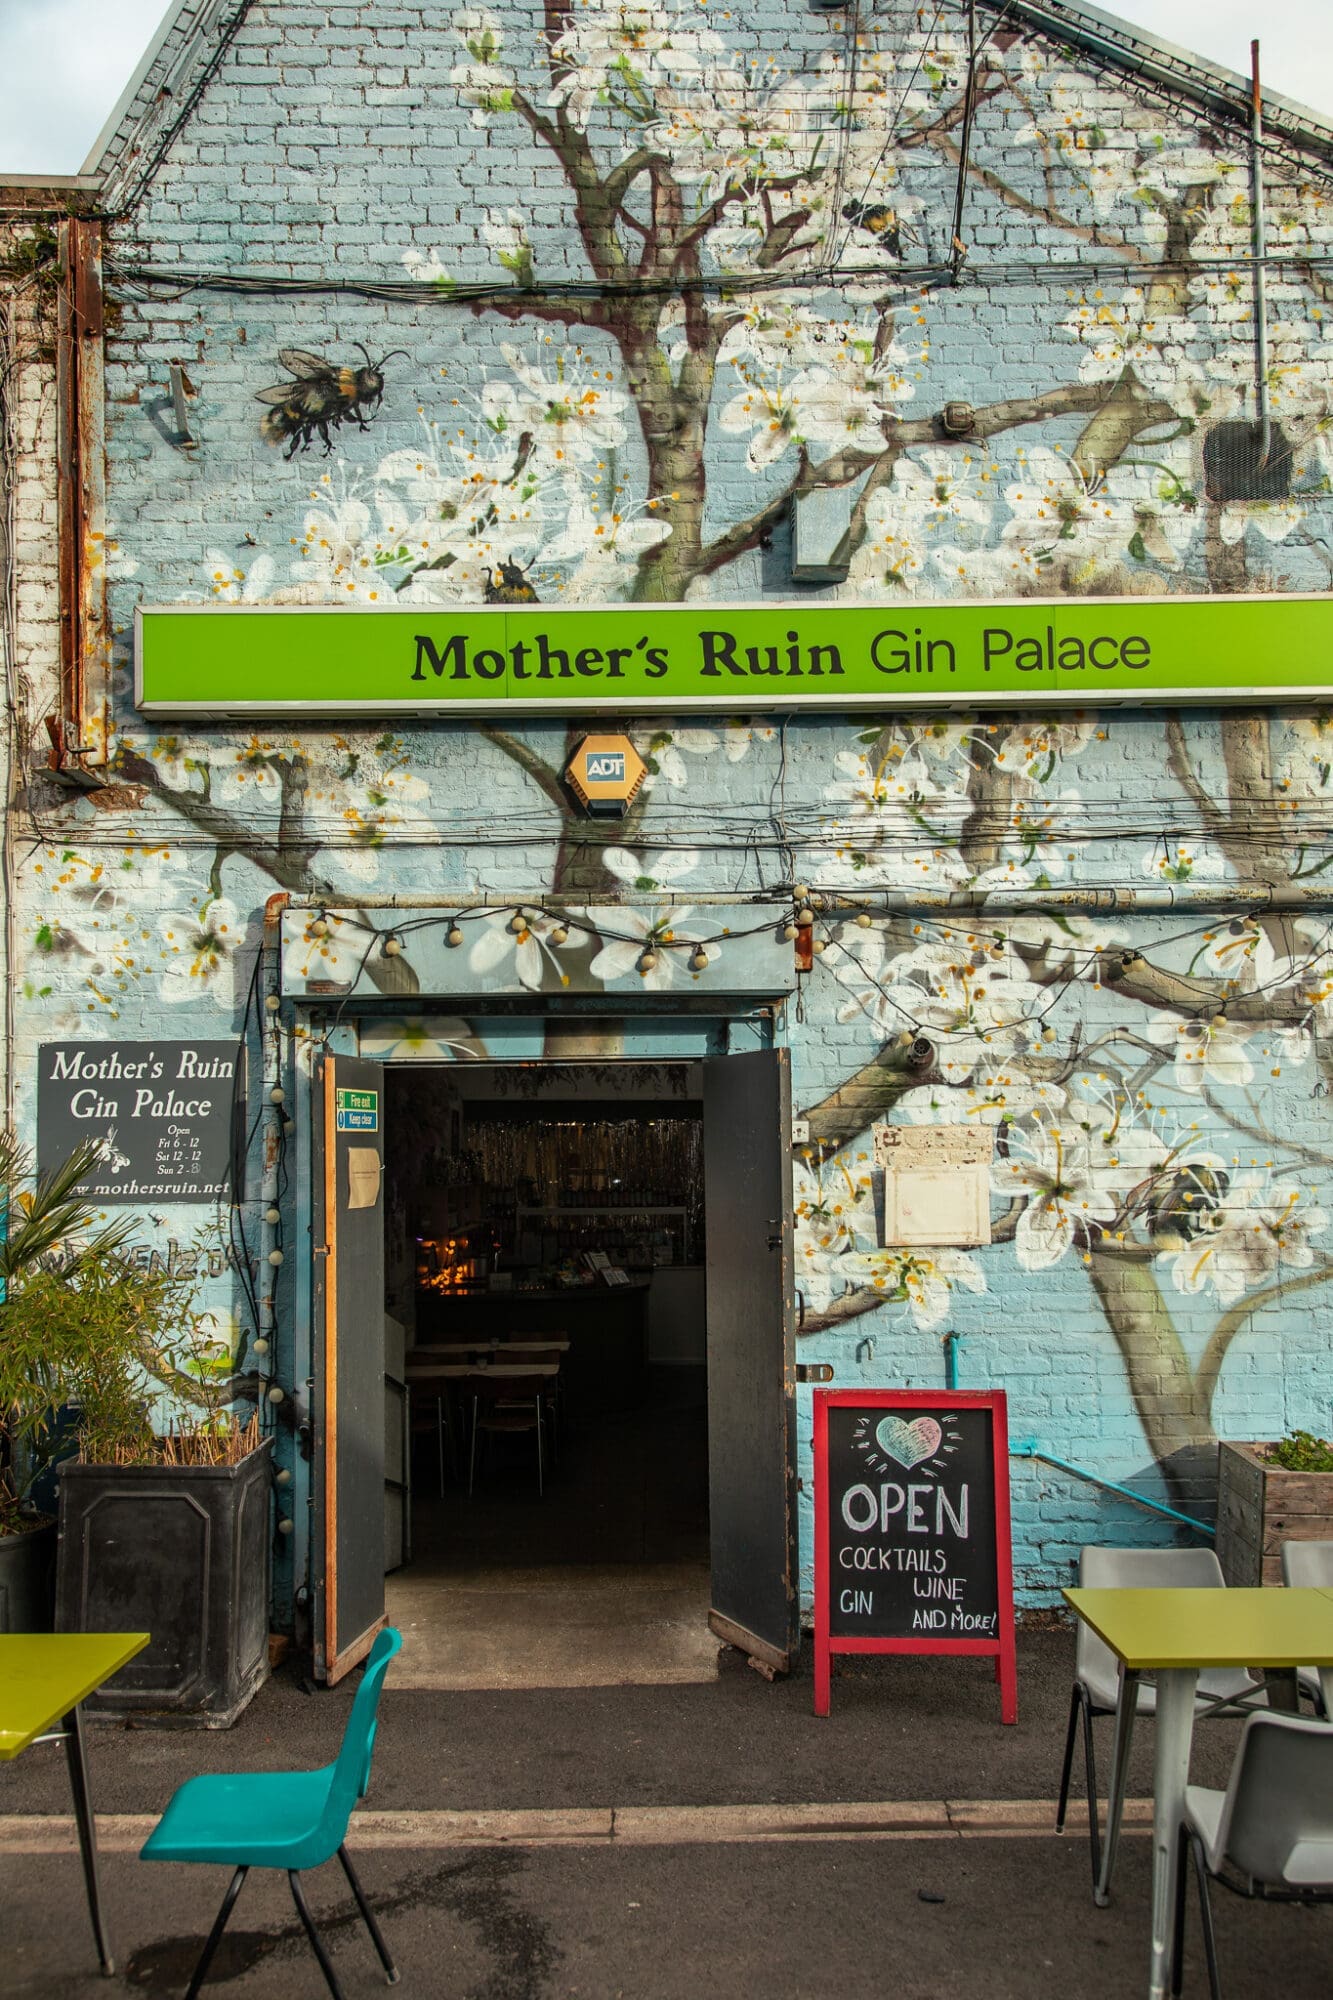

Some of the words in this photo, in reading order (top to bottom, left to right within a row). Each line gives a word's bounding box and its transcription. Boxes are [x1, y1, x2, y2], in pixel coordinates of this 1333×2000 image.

[411, 635, 668, 681] Mother's
[699, 631, 845, 677] Ruin
[870, 629, 956, 674] Gin
[983, 625, 1151, 672] Palace
[588, 759, 624, 776] ADT
[49, 1051, 164, 1080] Mother's
[176, 1050, 233, 1079] Ruin
[70, 1089, 118, 1119] Gin
[131, 1089, 212, 1118] Palace
[158, 1137, 171, 1149] Fri
[173, 1137, 180, 1148] 6
[189, 1137, 200, 1148] 12
[168, 1124, 191, 1137] Open
[155, 1151, 170, 1162] Sat
[172, 1151, 183, 1161] 12
[191, 1150, 202, 1161] 12
[157, 1164, 174, 1175] Sun
[176, 1164, 184, 1174] 2
[841, 1483, 969, 1539] OPEN
[839, 1546, 947, 1574] COCKTAILS
[840, 1589, 873, 1615] GIN
[914, 1577, 967, 1601] WINE
[912, 1609, 946, 1630] AND
[951, 1611, 997, 1636] MORE!
